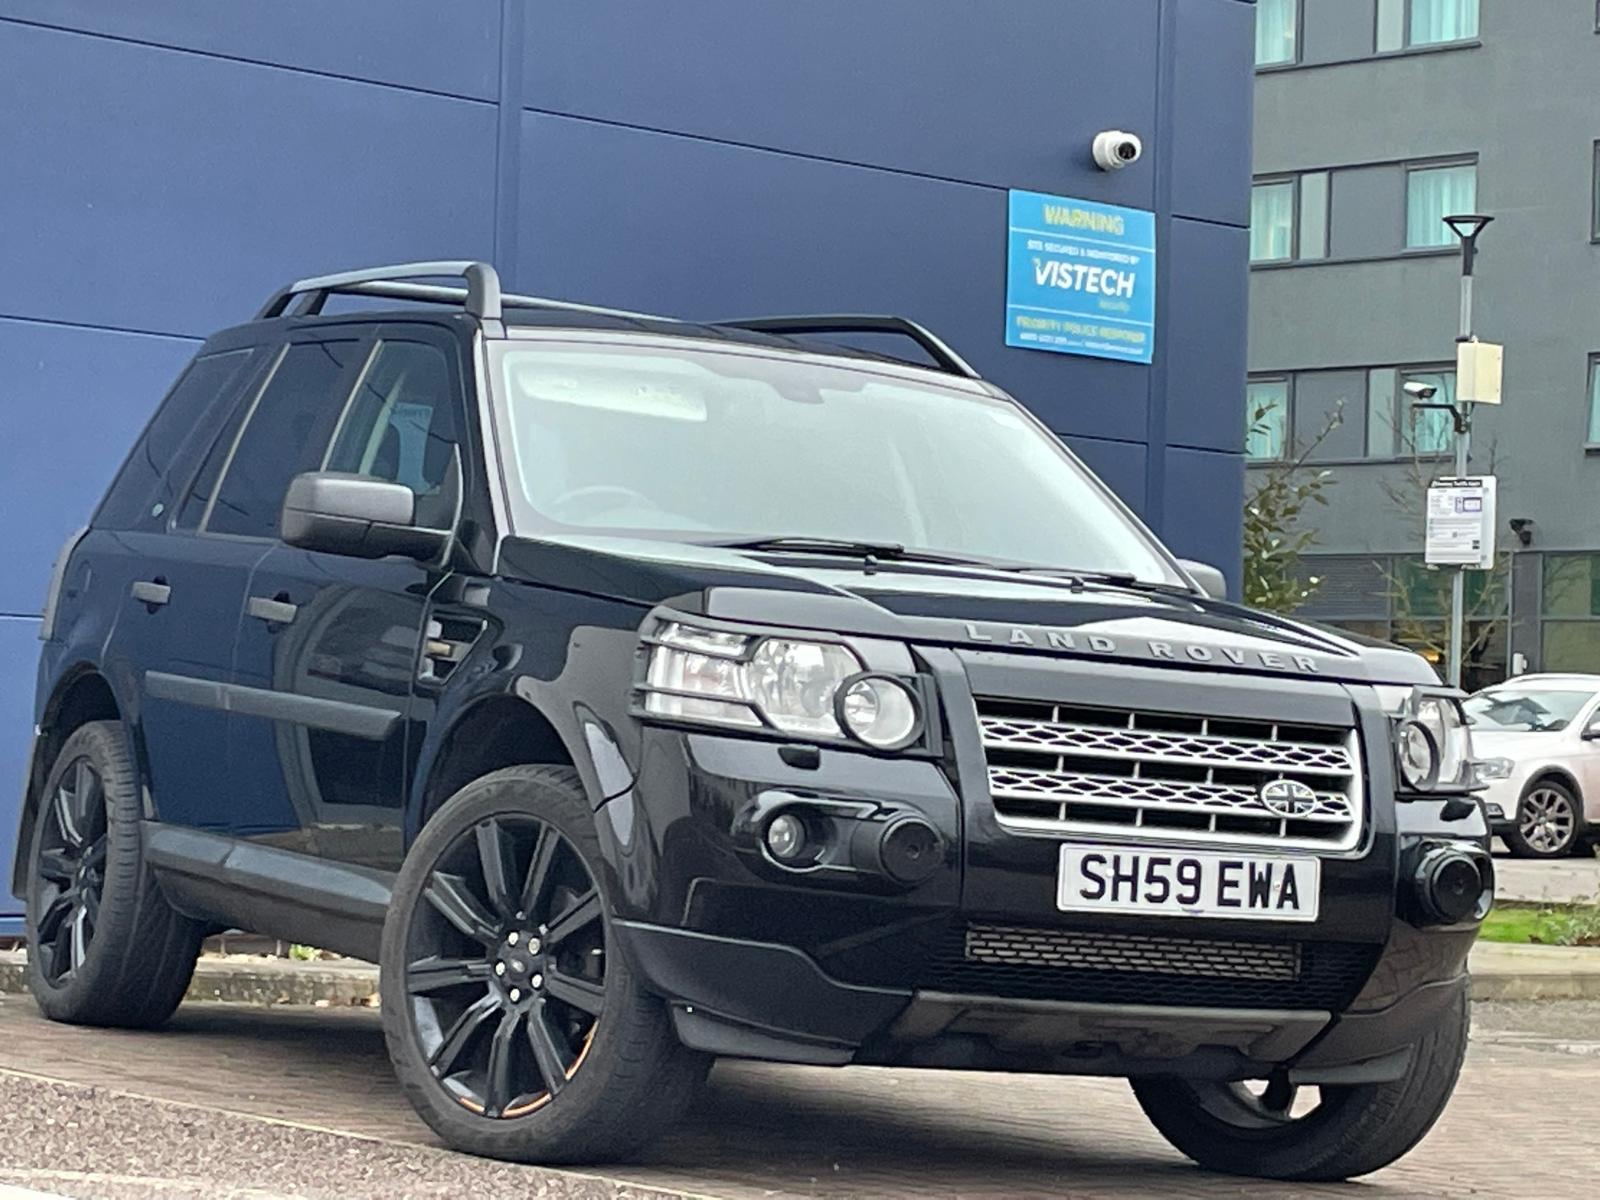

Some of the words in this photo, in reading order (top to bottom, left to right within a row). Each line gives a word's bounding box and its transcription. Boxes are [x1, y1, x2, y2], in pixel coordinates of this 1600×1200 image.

[1044, 205, 1124, 235] WARNING
[1033, 258, 1136, 298] VISTECH
[965, 623, 1117, 653] LAND
[1147, 641, 1320, 673] ROVER
[1079, 853, 1202, 905] SH59
[1216, 860, 1300, 910] EWA
